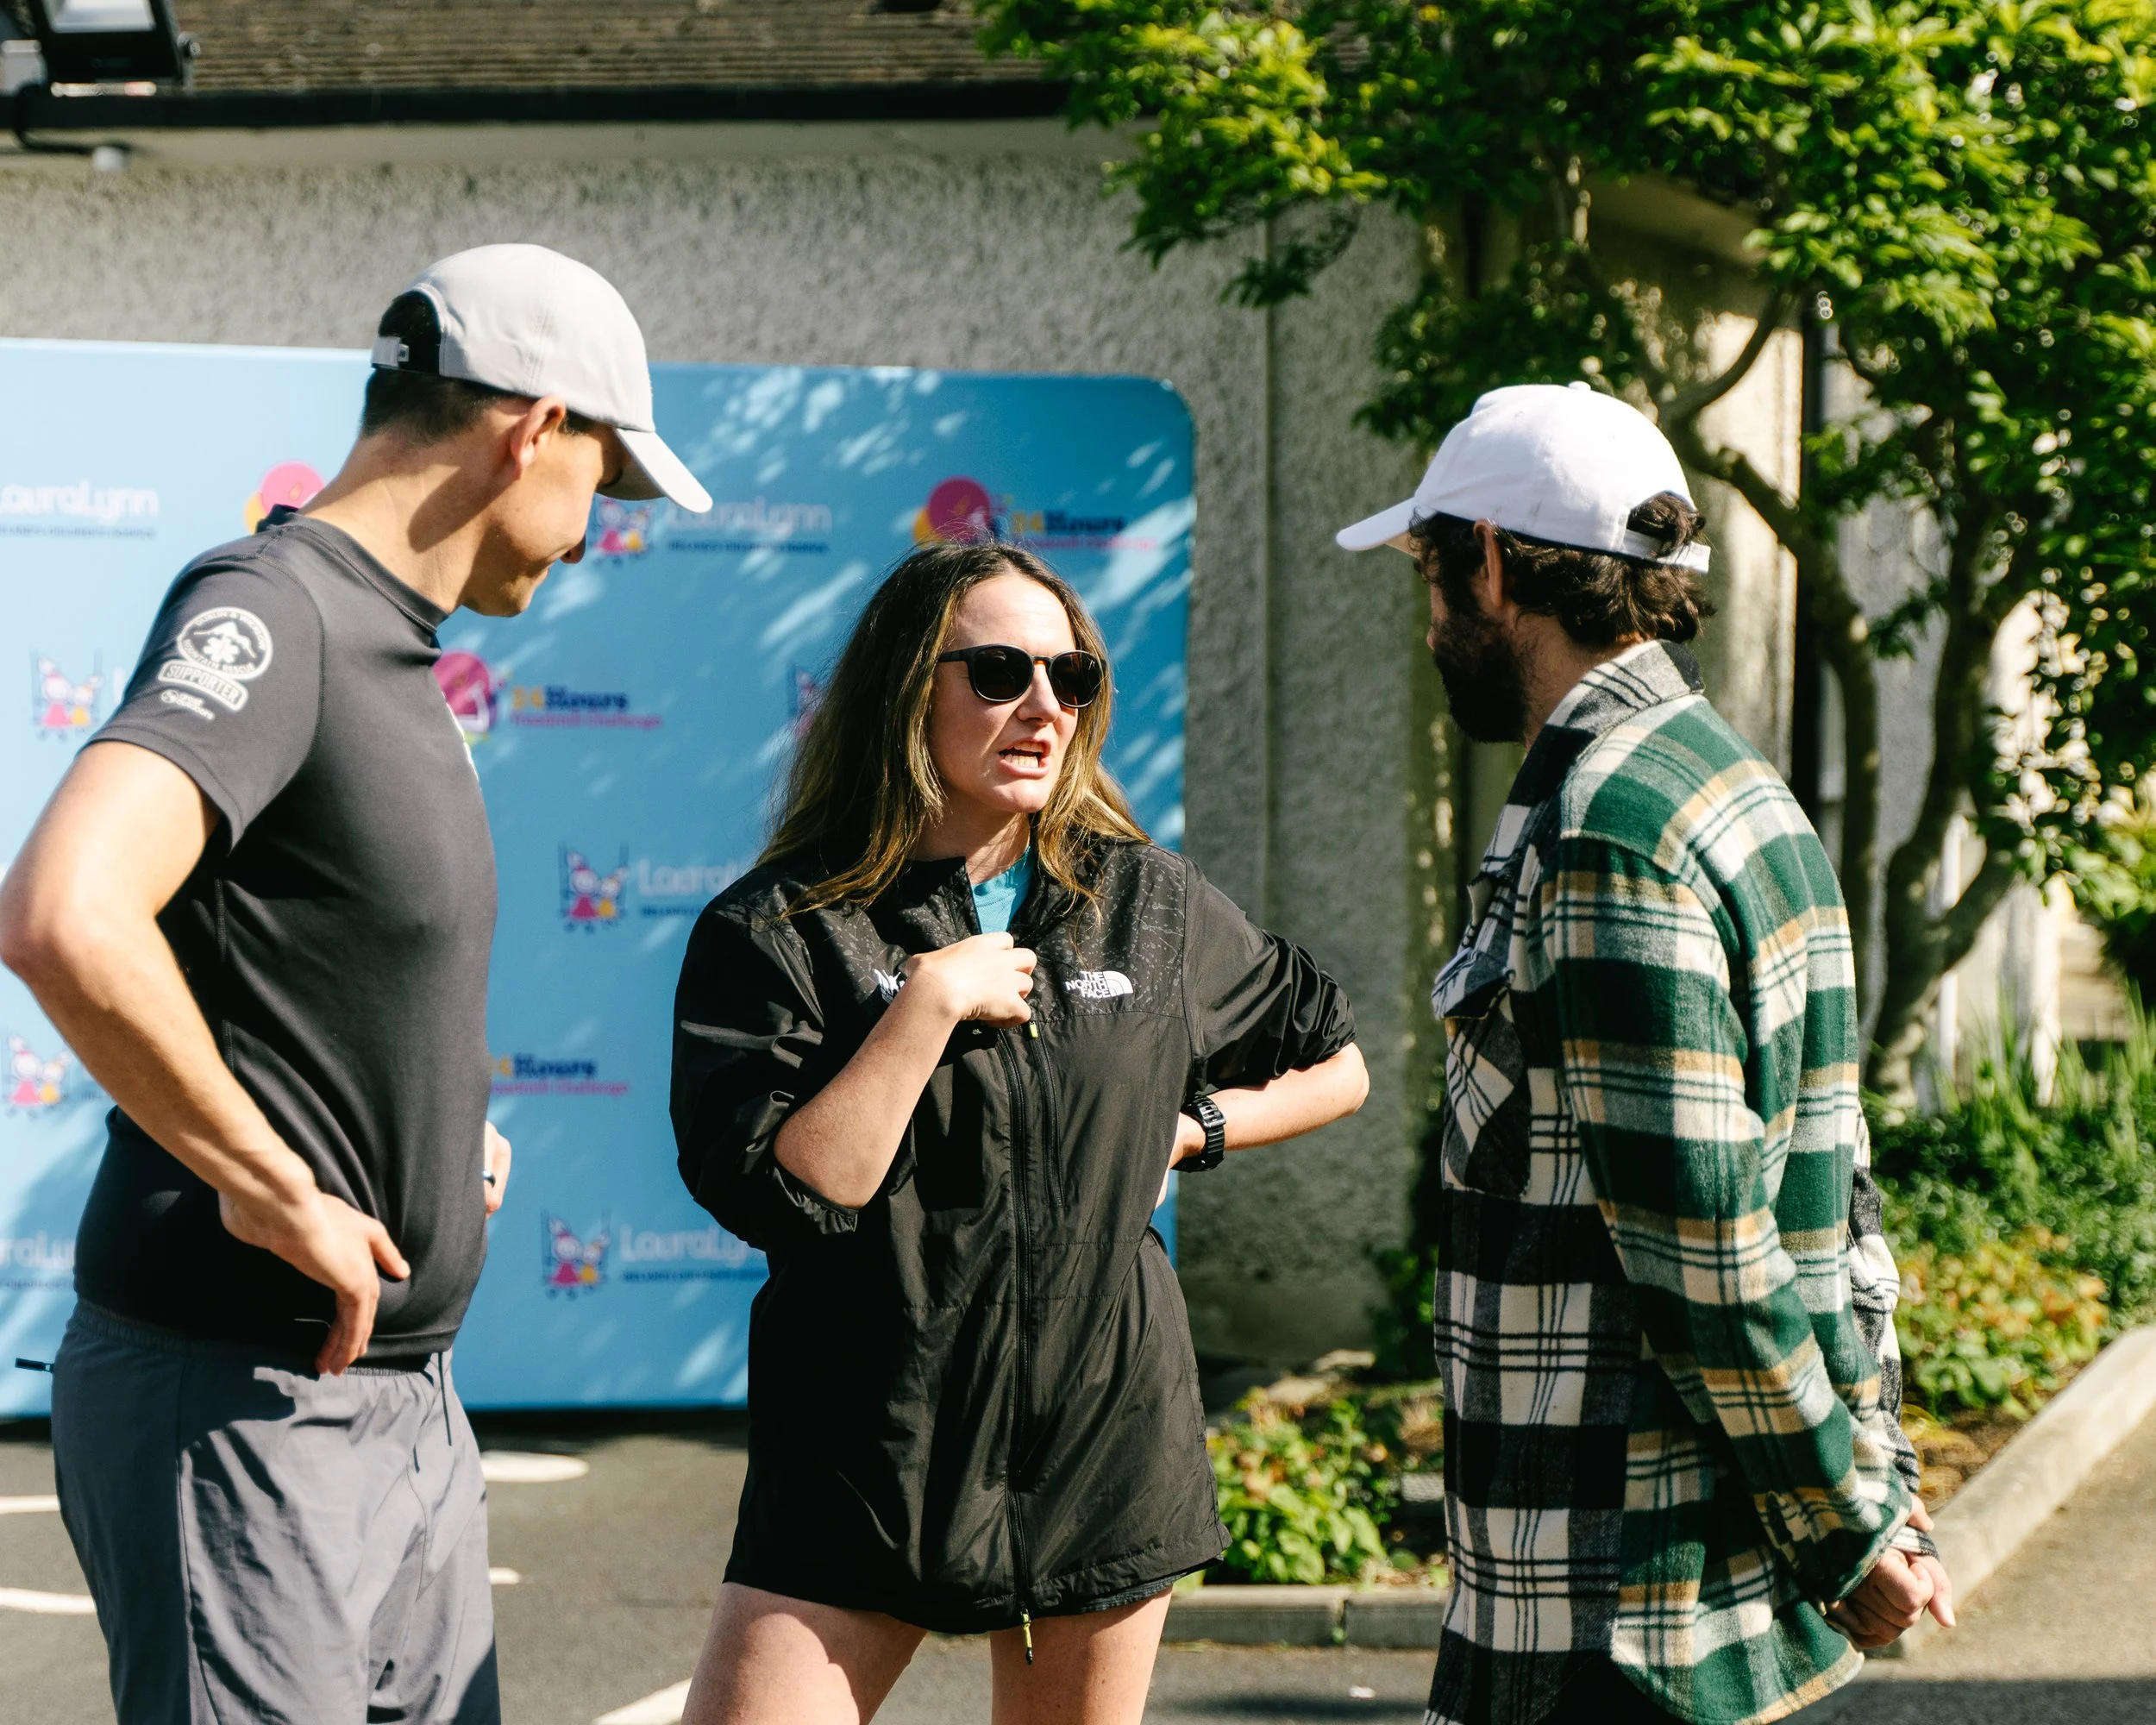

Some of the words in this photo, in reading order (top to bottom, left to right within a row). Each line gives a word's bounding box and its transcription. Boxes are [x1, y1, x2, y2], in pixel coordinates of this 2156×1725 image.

[0, 480, 159, 524] auraLynn
[166, 664, 241, 706] SUPPORTER
[1079, 970, 1105, 982] THE
[1064, 979, 1108, 991] NORTH
[1080, 988, 1112, 999] FACE
